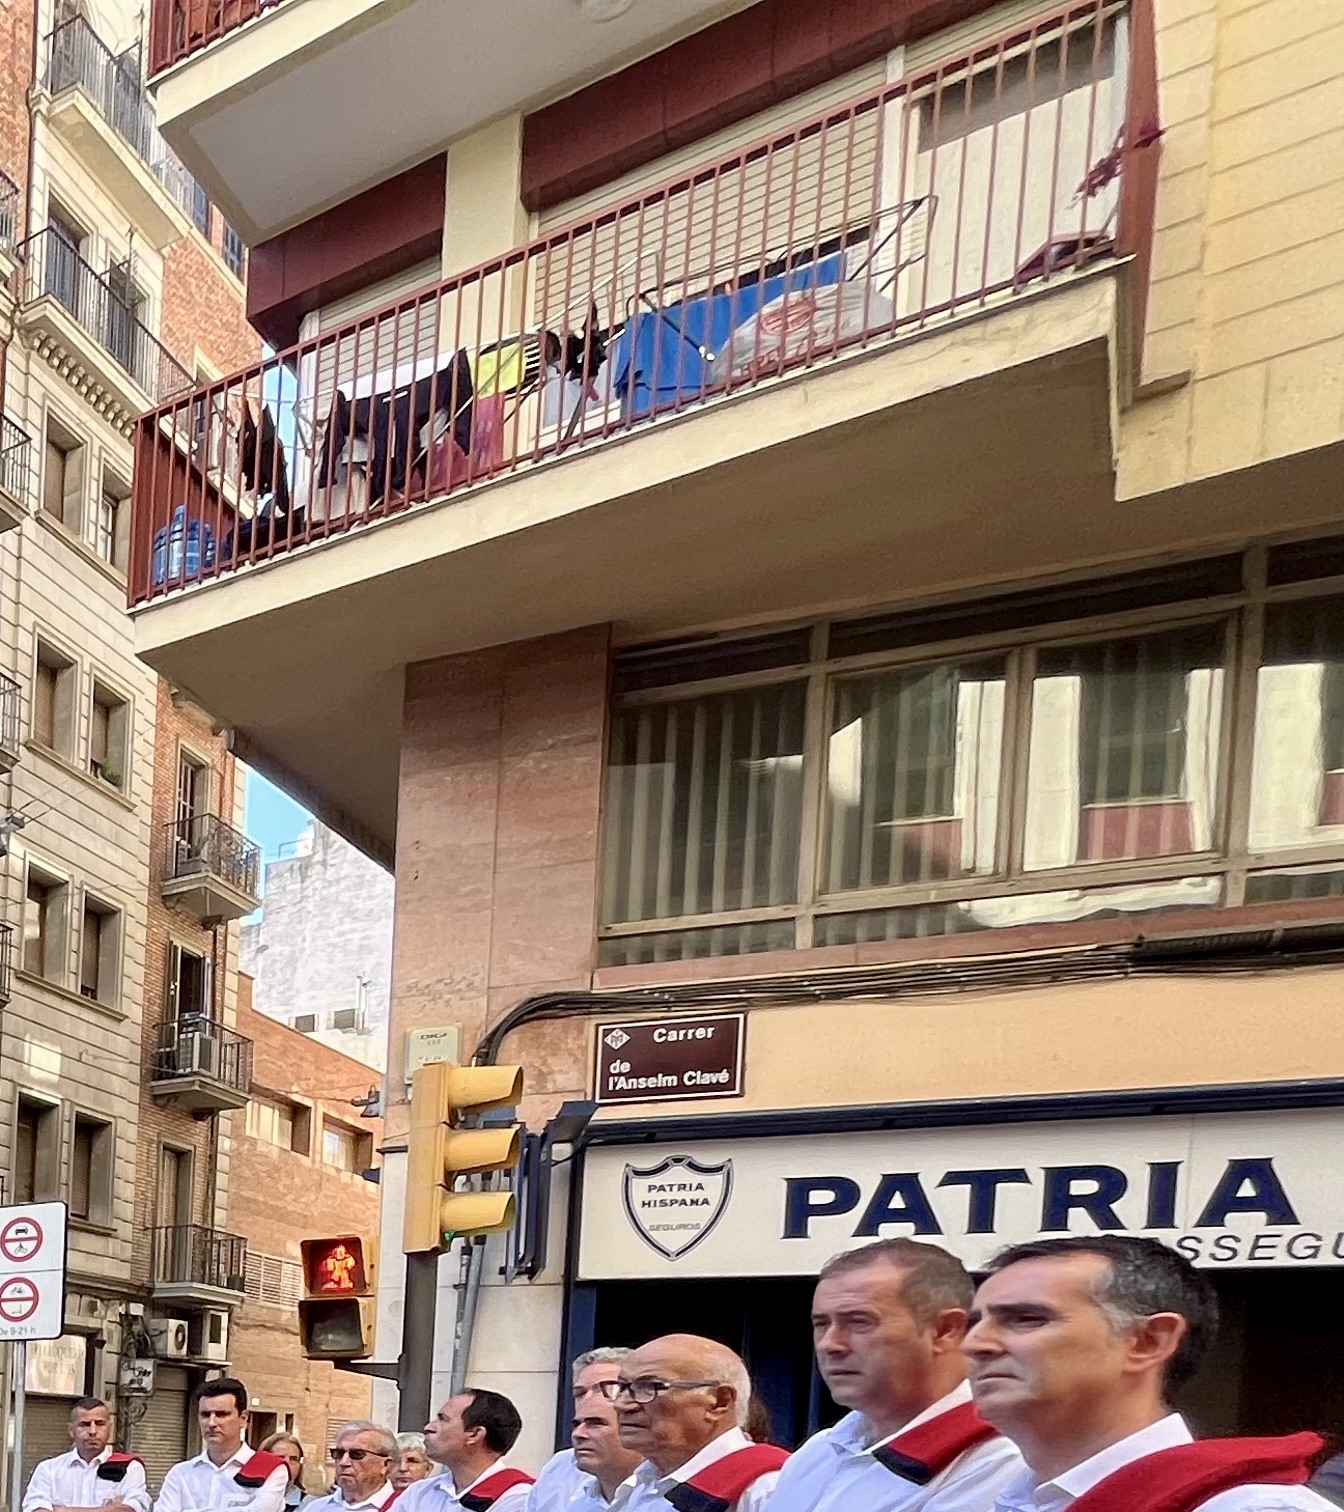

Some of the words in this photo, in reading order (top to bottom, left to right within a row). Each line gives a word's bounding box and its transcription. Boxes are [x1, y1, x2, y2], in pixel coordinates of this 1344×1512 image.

[652, 1026, 716, 1043] Carrer
[609, 1059, 631, 1074] de
[608, 1072, 678, 1091] l'Anselm
[682, 1068, 730, 1086] Clavé
[647, 1182, 705, 1194] PATRIA
[640, 1197, 711, 1209] HISPANA
[779, 1157, 1302, 1240] PATRIA
[647, 1222, 702, 1232] SEGUROS
